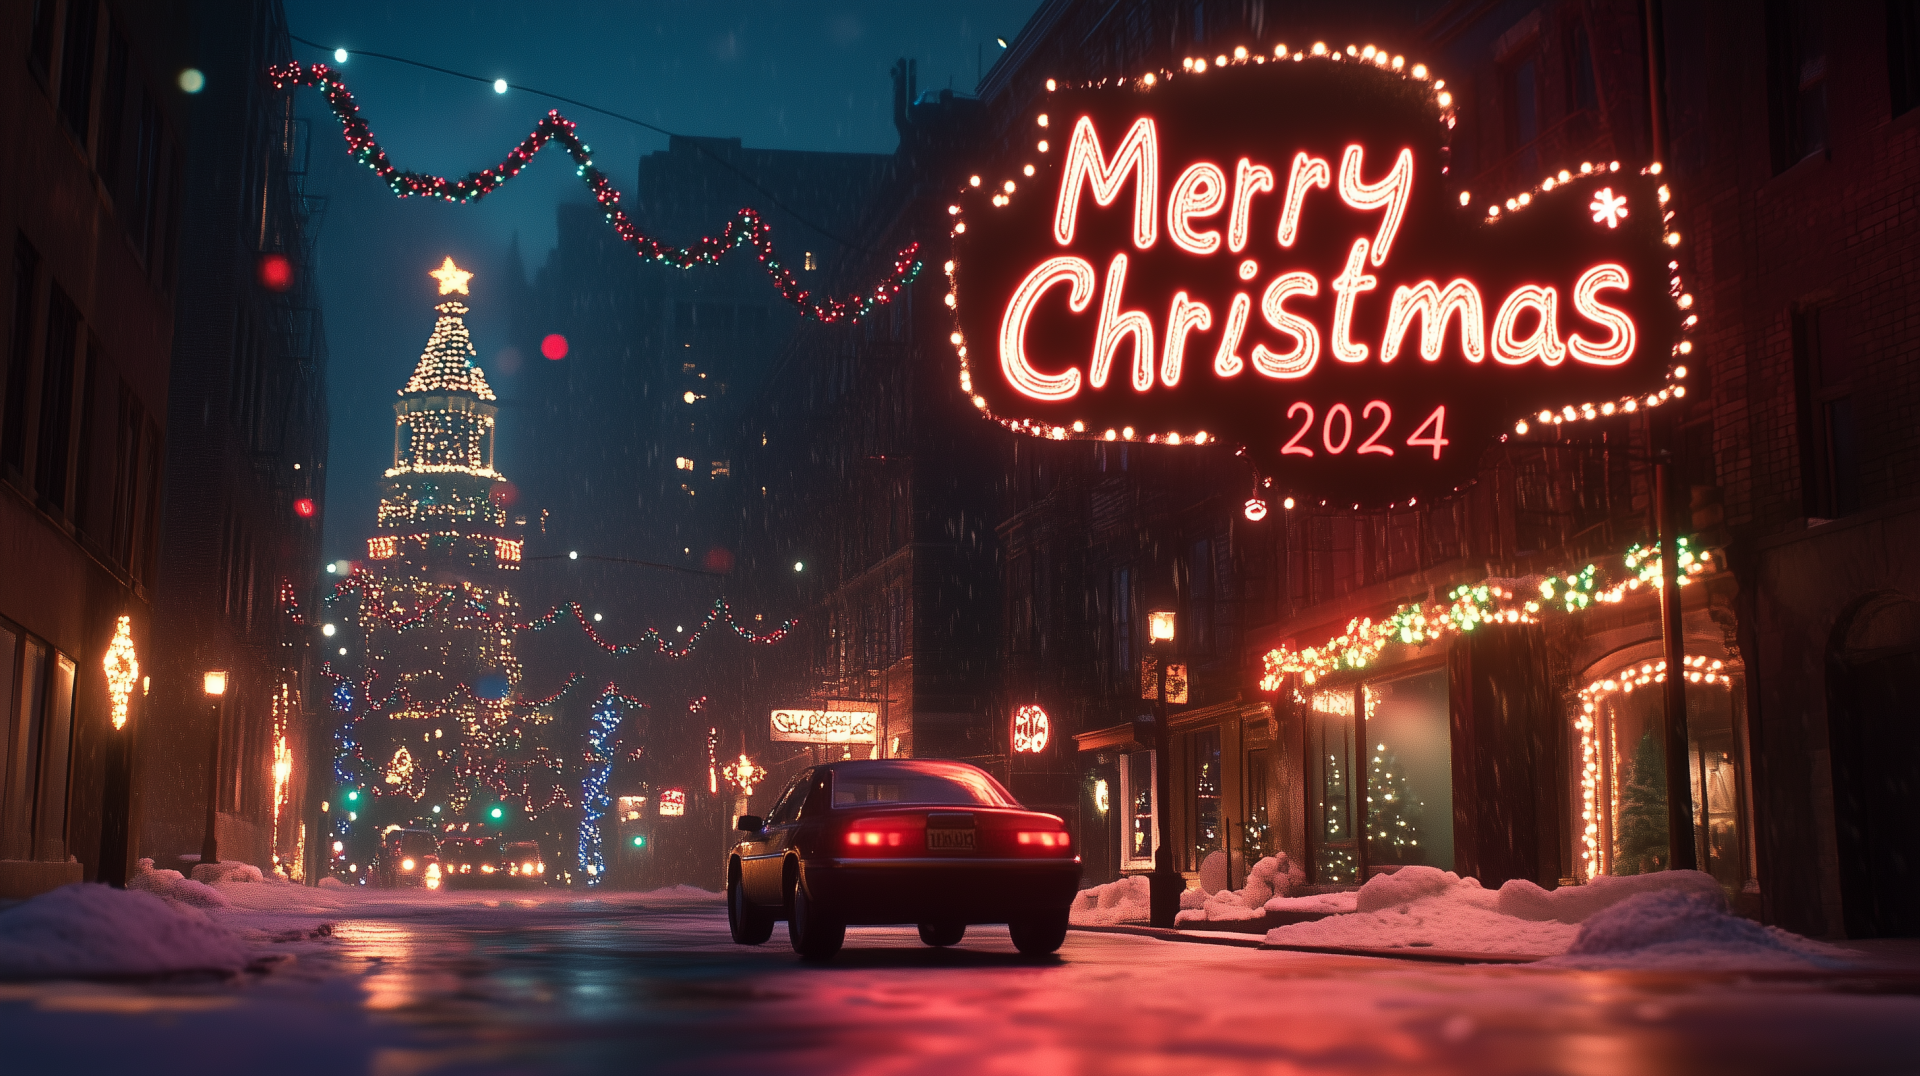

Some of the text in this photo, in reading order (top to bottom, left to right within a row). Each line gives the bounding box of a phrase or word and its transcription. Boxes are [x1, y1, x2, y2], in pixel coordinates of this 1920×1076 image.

[1054, 115, 1413, 266] Merry
[1000, 236, 1636, 400] Christmas
[1280, 399, 1450, 460] 2024
